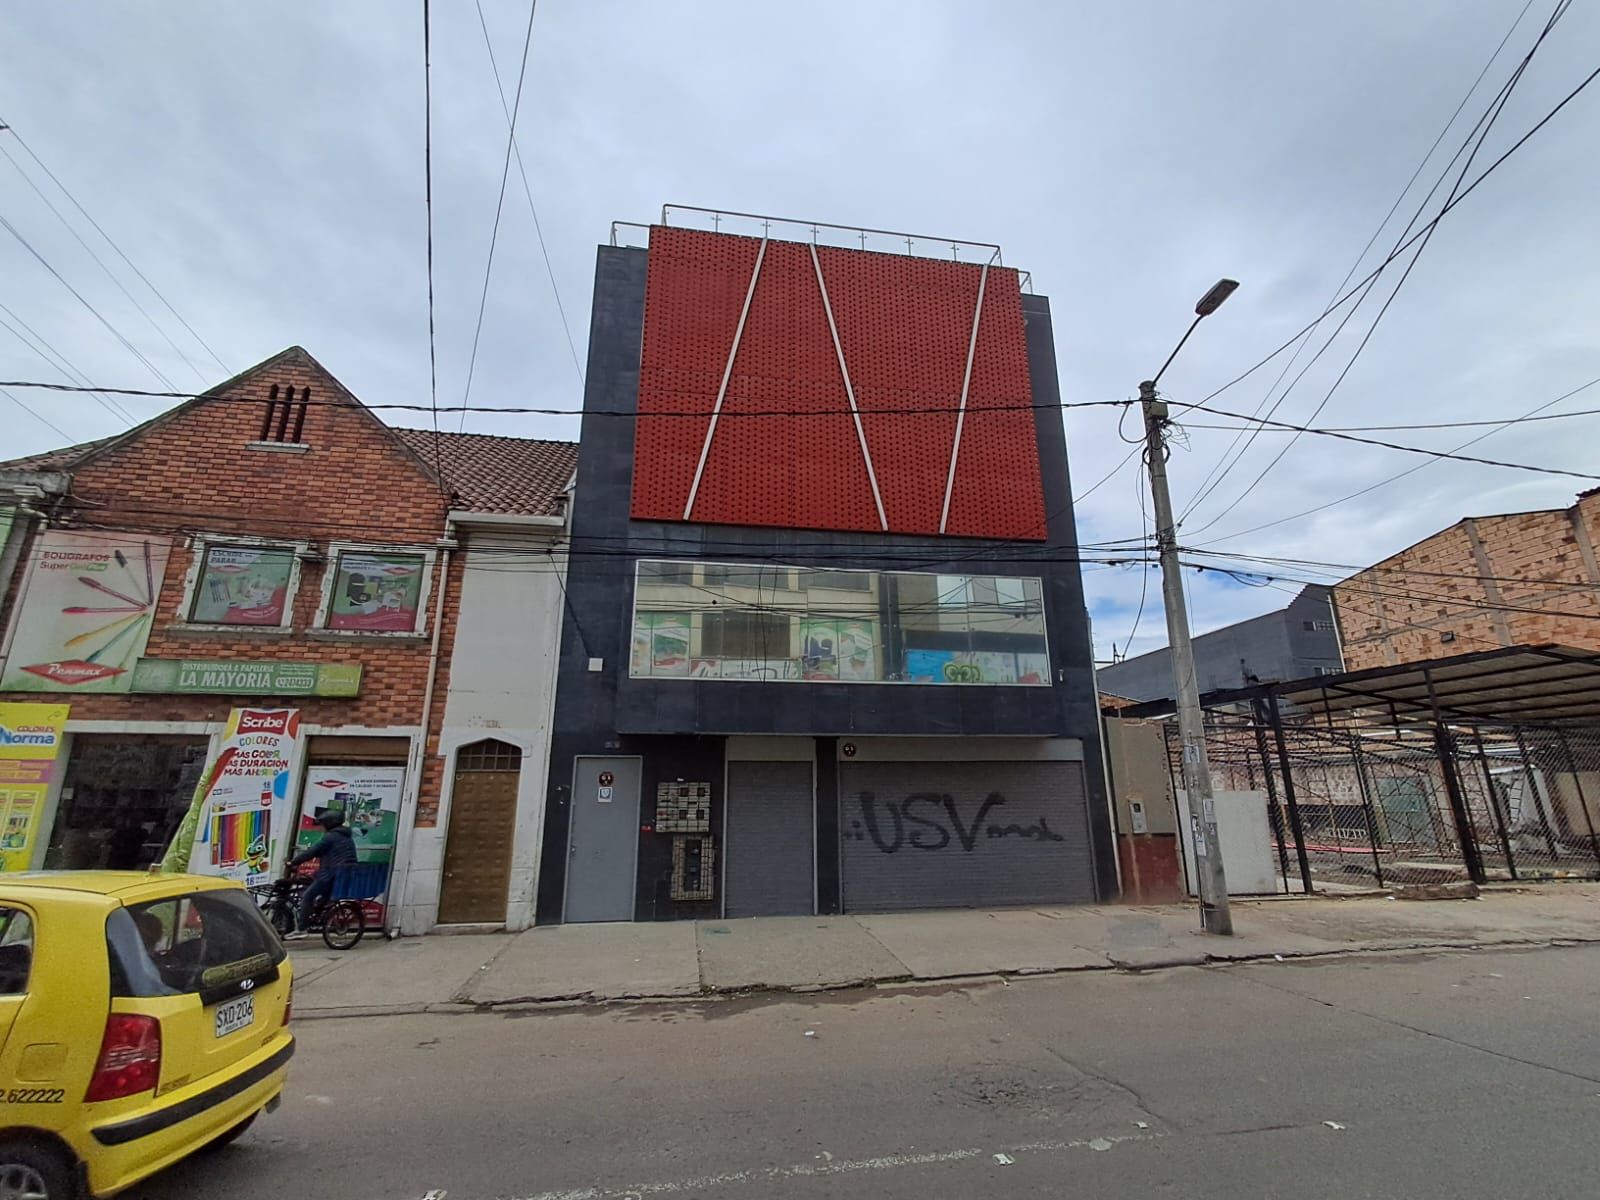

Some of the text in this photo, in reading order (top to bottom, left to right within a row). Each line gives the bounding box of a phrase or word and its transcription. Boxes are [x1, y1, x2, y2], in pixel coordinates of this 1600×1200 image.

[180, 671, 197, 686] LA
[201, 672, 271, 687] MAYORIA
[242, 716, 284, 728] Scribe
[0, 725, 55, 744] Norma
[240, 736, 279, 746] COLORES
[237, 999, 252, 1020] 206
